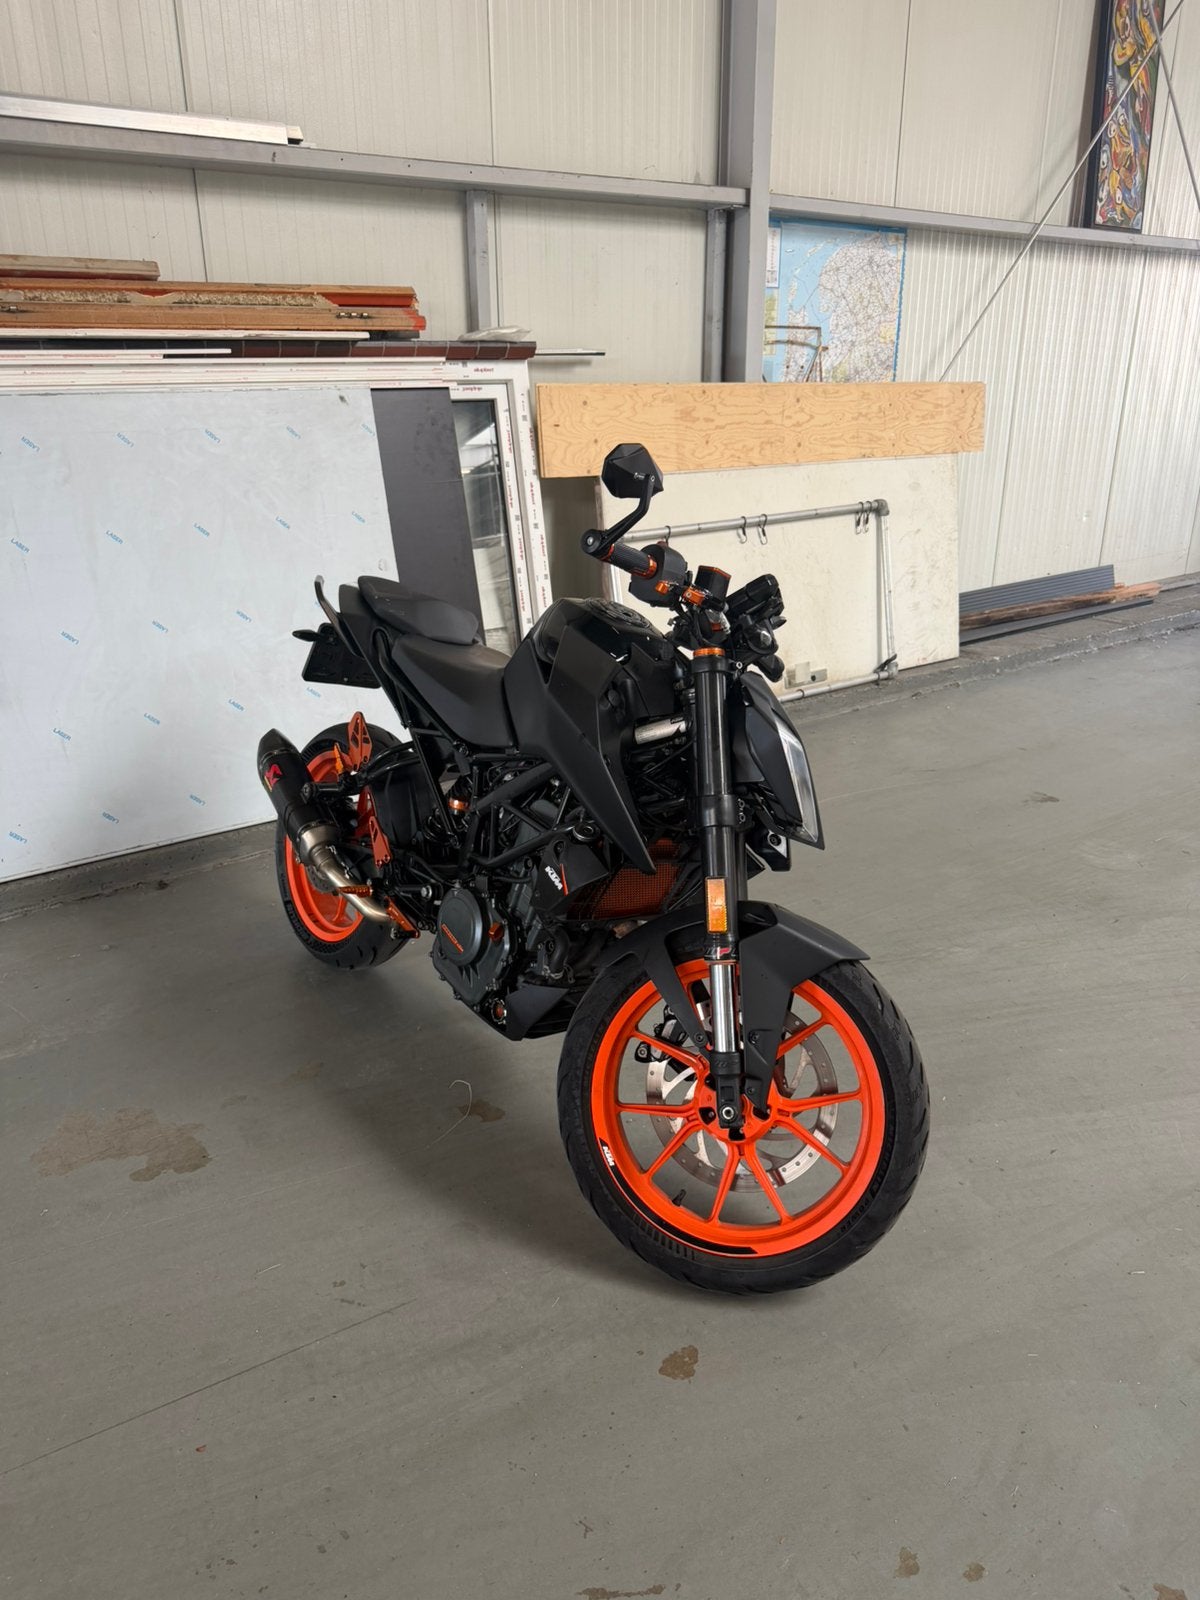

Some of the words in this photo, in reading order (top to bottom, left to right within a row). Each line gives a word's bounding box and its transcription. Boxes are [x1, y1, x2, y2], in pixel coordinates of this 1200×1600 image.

[20, 436, 40, 452] LASER
[105, 530, 123, 544] LASER
[193, 523, 209, 537] LASER
[10, 538, 29, 553] LASER
[143, 713, 160, 725] LASER
[52, 728, 71, 741] LASER
[545, 866, 563, 891] KTM
[602, 1145, 615, 1166] KTM
